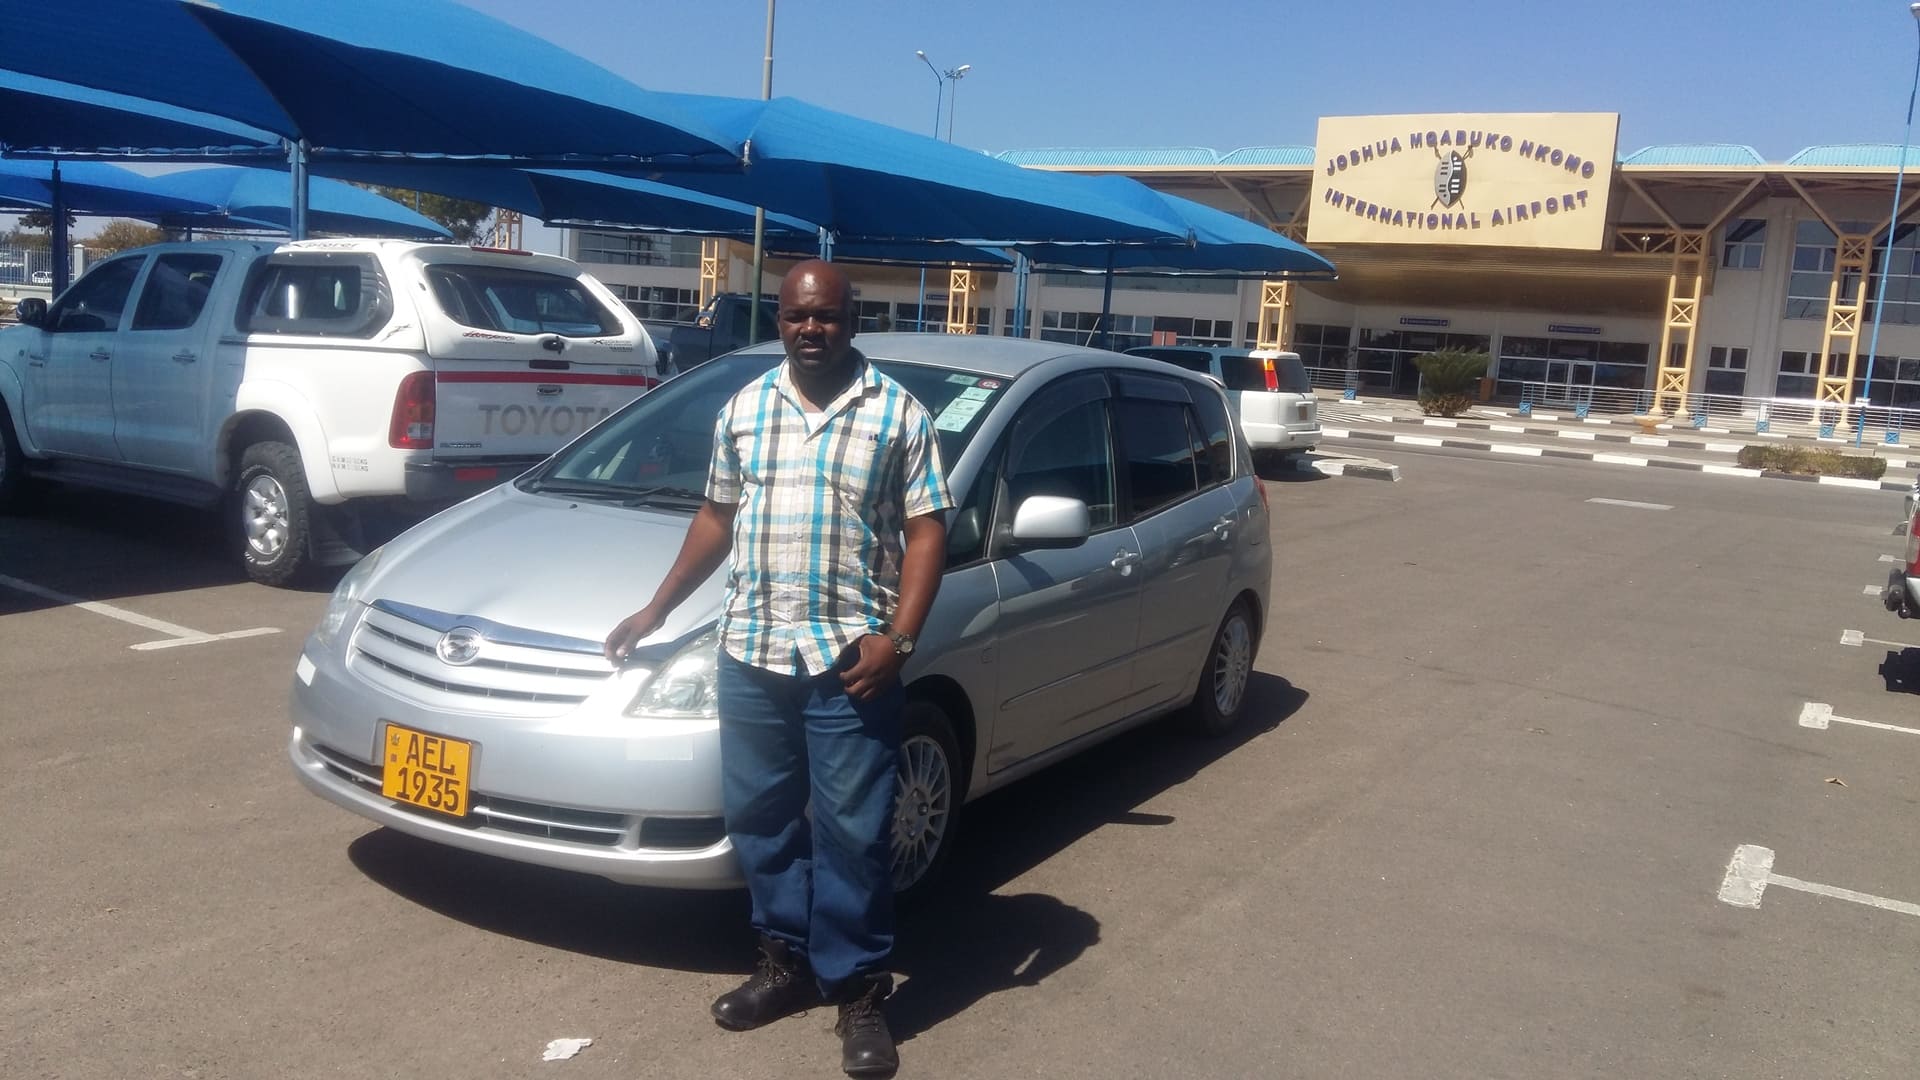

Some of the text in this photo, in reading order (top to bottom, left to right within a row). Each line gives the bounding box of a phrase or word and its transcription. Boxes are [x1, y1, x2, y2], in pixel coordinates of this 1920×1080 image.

[1327, 137, 1402, 177] JOSHUA
[1519, 139, 1594, 179] NKOMO
[1325, 188, 1589, 231] INTERNATIONAL AIRPORT
[406, 733, 455, 775] AEL
[396, 767, 460, 812] 1935
